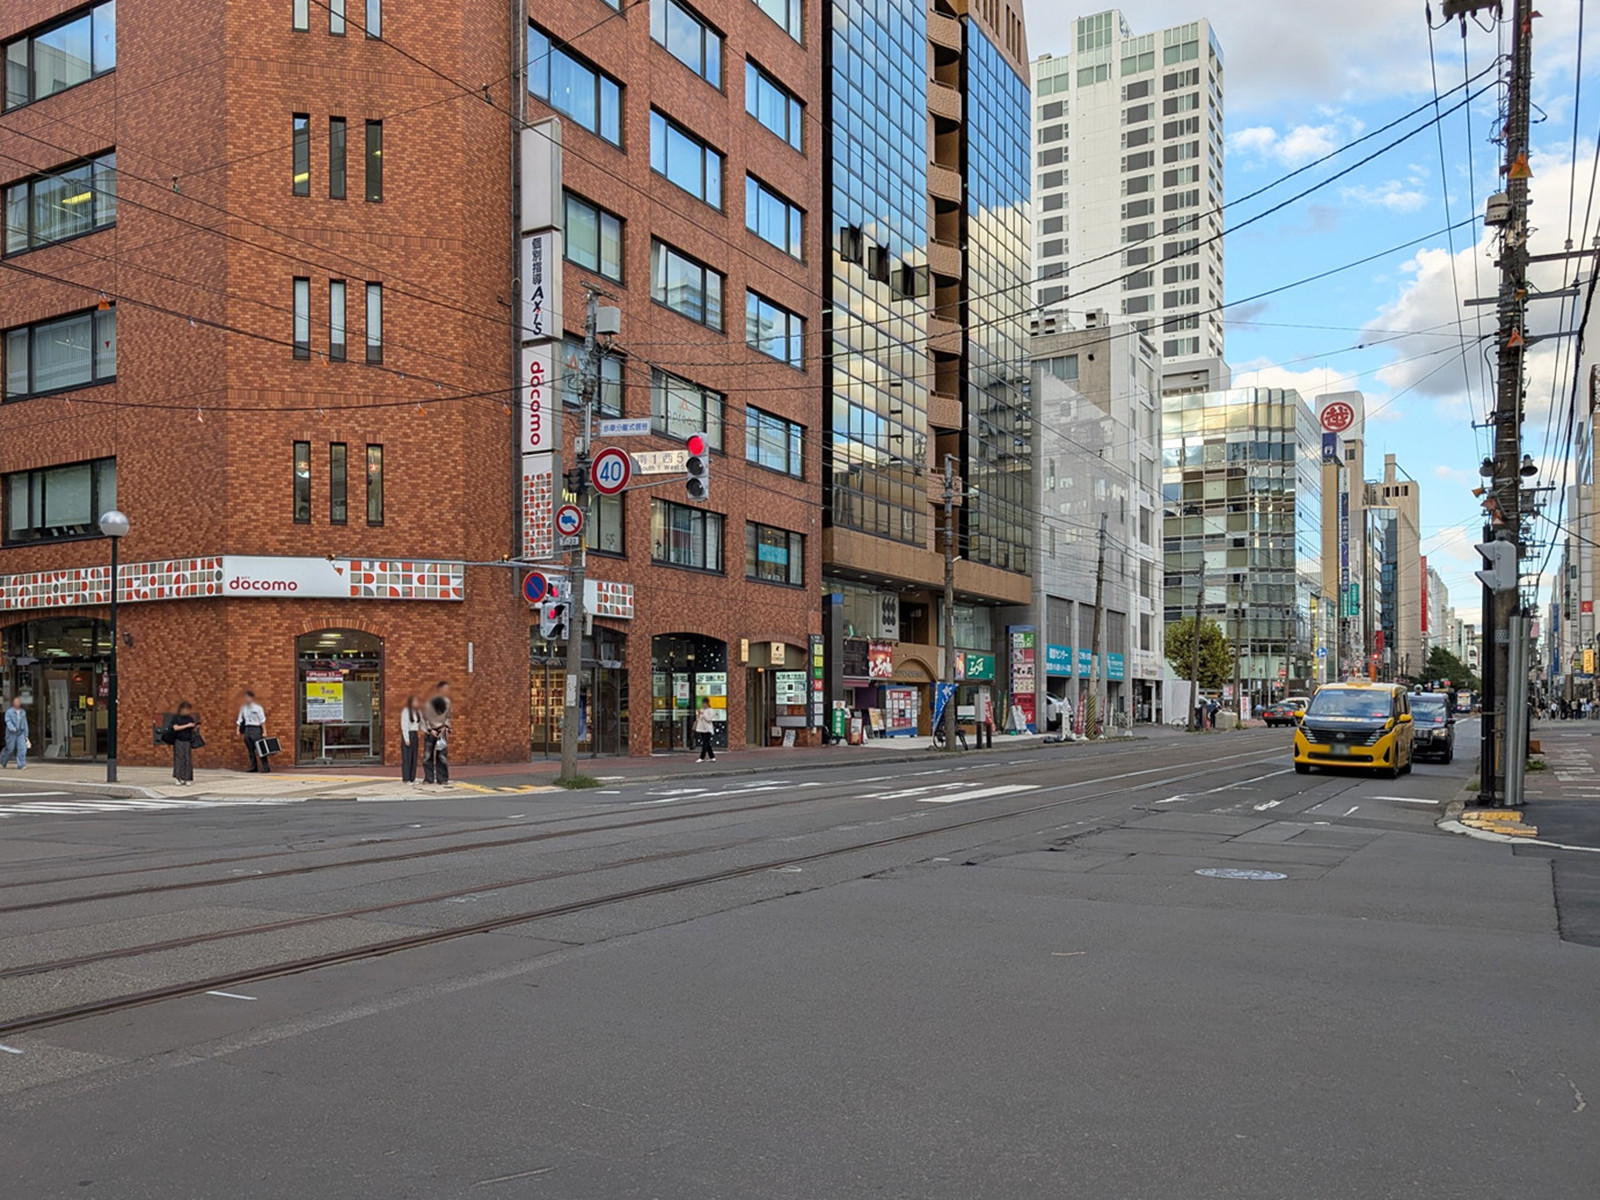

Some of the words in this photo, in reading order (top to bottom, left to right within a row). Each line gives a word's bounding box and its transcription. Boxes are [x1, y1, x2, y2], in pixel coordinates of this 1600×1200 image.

[530, 361, 544, 445] docomo
[600, 462, 621, 481] 40
[229, 576, 298, 591] docomo
